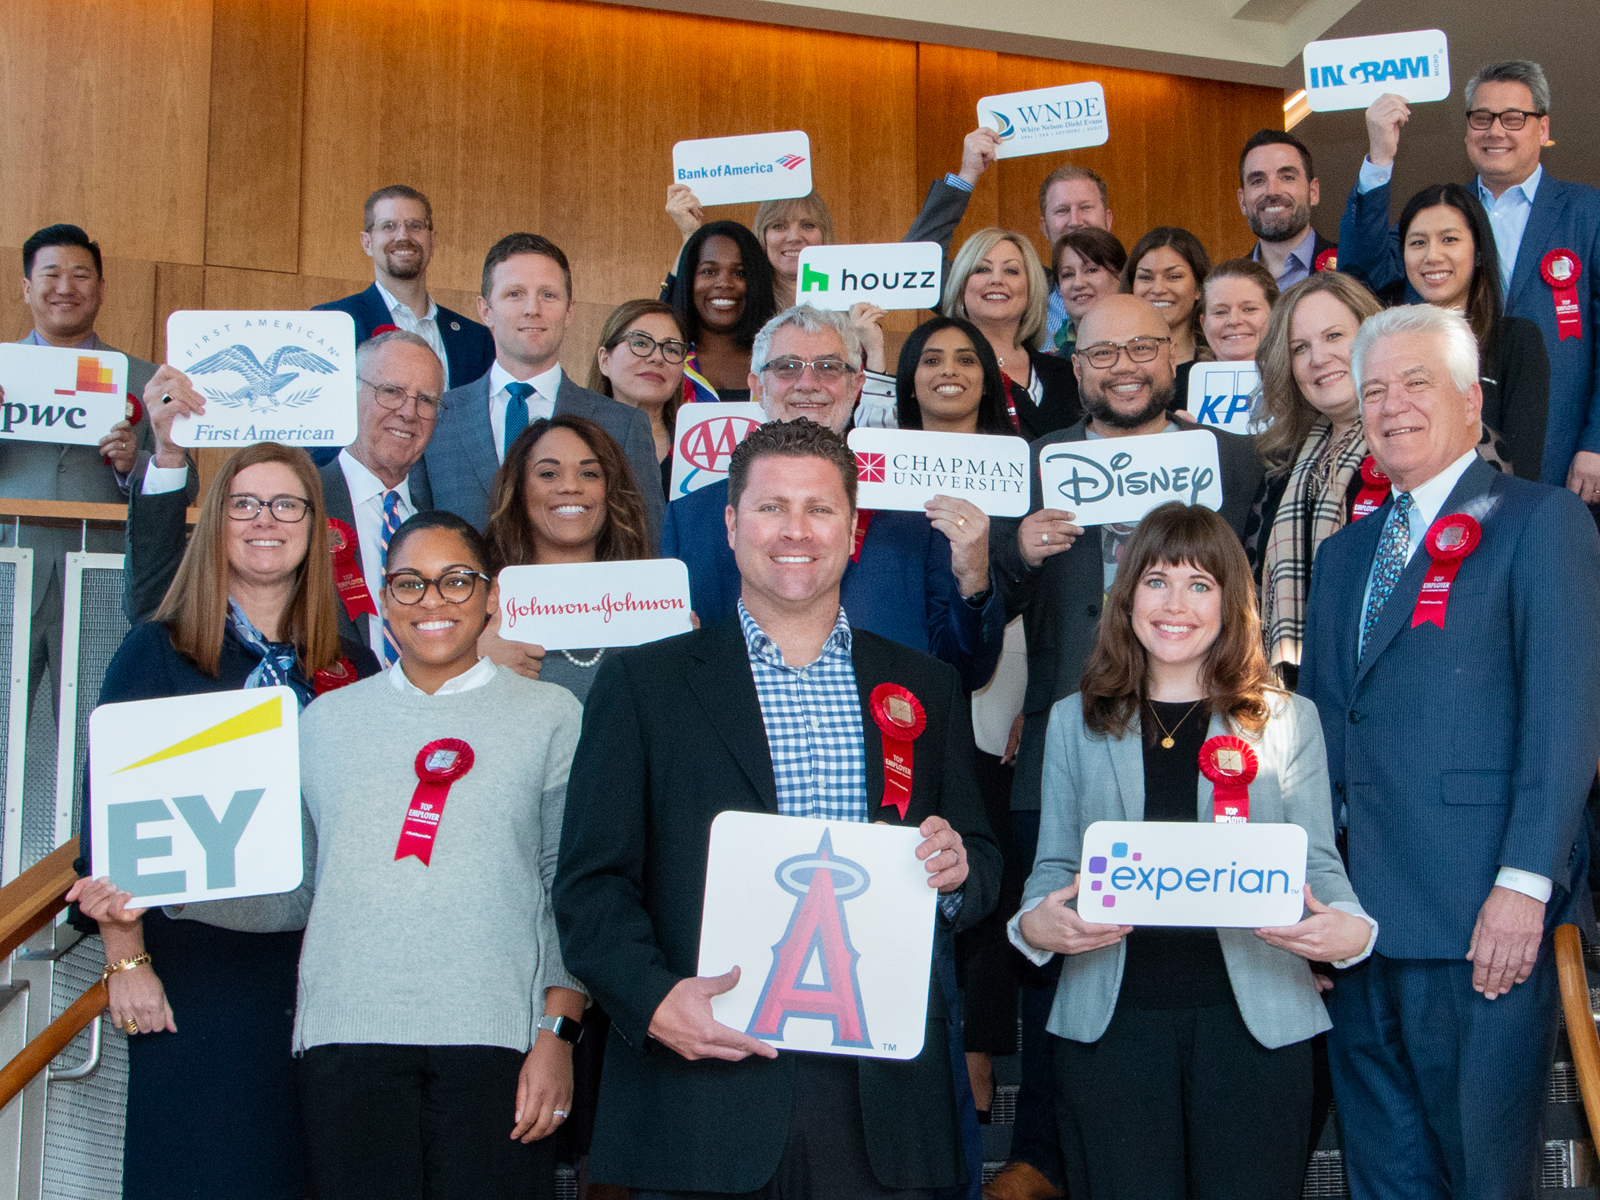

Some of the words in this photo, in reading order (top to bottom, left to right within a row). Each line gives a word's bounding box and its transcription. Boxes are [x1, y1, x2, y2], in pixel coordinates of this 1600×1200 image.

[1309, 55, 1430, 89] INGRAM
[1432, 54, 1440, 77] MICRO
[1017, 97, 1101, 124] WNDE
[1041, 123, 1063, 131] Nelson
[1064, 120, 1083, 128] Diehl
[678, 167, 708, 180] Bank
[709, 165, 722, 177] of
[723, 162, 774, 176] America
[841, 268, 936, 292] houzz
[186, 323, 231, 358] FIRST
[244, 319, 337, 356] AMERICAN
[1, 401, 87, 433] pwc
[194, 424, 240, 441] First
[242, 424, 335, 441] American
[684, 417, 762, 471] AA
[893, 453, 1025, 478] CHAPMAN
[893, 470, 1025, 494] UNIVERSITY
[1422, 581, 1450, 589] EMPLOYER
[885, 757, 912, 776] EMPLOYER
[893, 753, 904, 764] TOP
[408, 809, 440, 822] EMPLOYER
[420, 802, 433, 811] TOP
[1224, 806, 1238, 816] TOP
[107, 787, 267, 899] EY
[1111, 860, 1289, 900] experian
[745, 827, 874, 1050] A
[882, 1042, 898, 1051] TM
